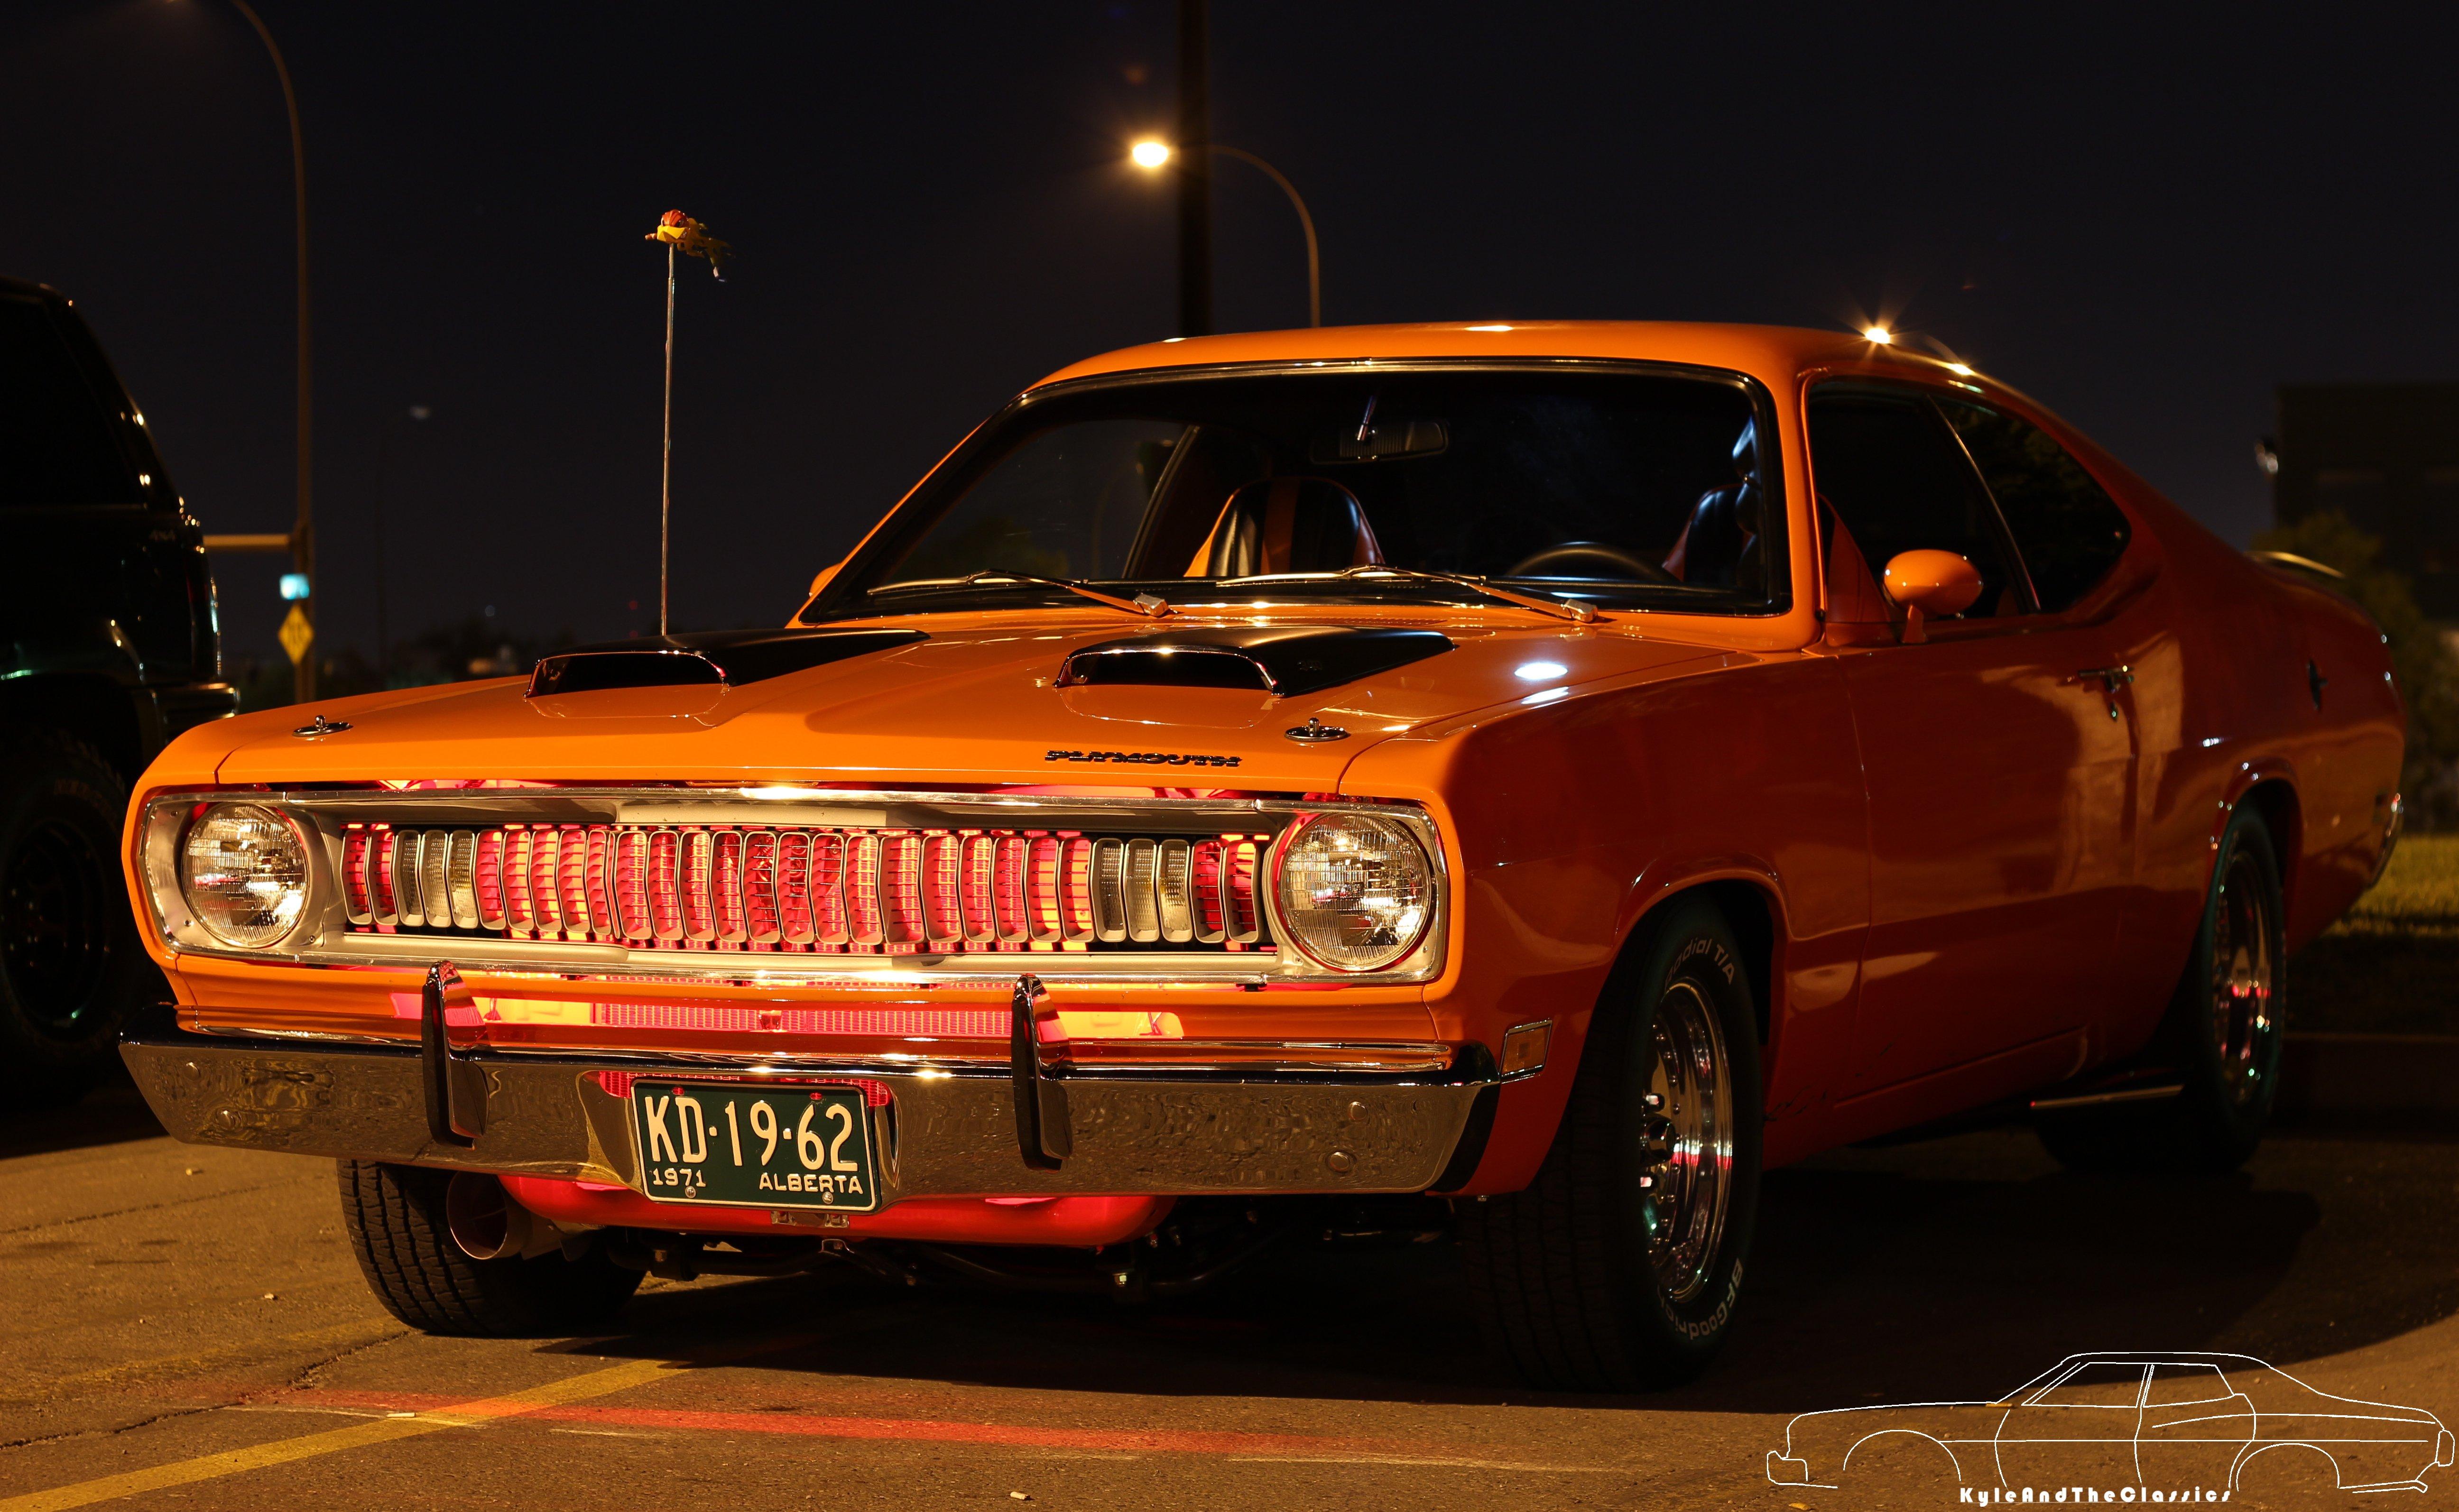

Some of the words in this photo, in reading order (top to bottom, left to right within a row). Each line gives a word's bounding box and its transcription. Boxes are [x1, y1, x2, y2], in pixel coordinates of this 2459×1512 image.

[1045, 750, 1242, 767] PLYMOUTH
[1714, 944, 1735, 985] T/A
[653, 1168, 706, 1187] 1971
[759, 1173, 863, 1194] ALBERTA
